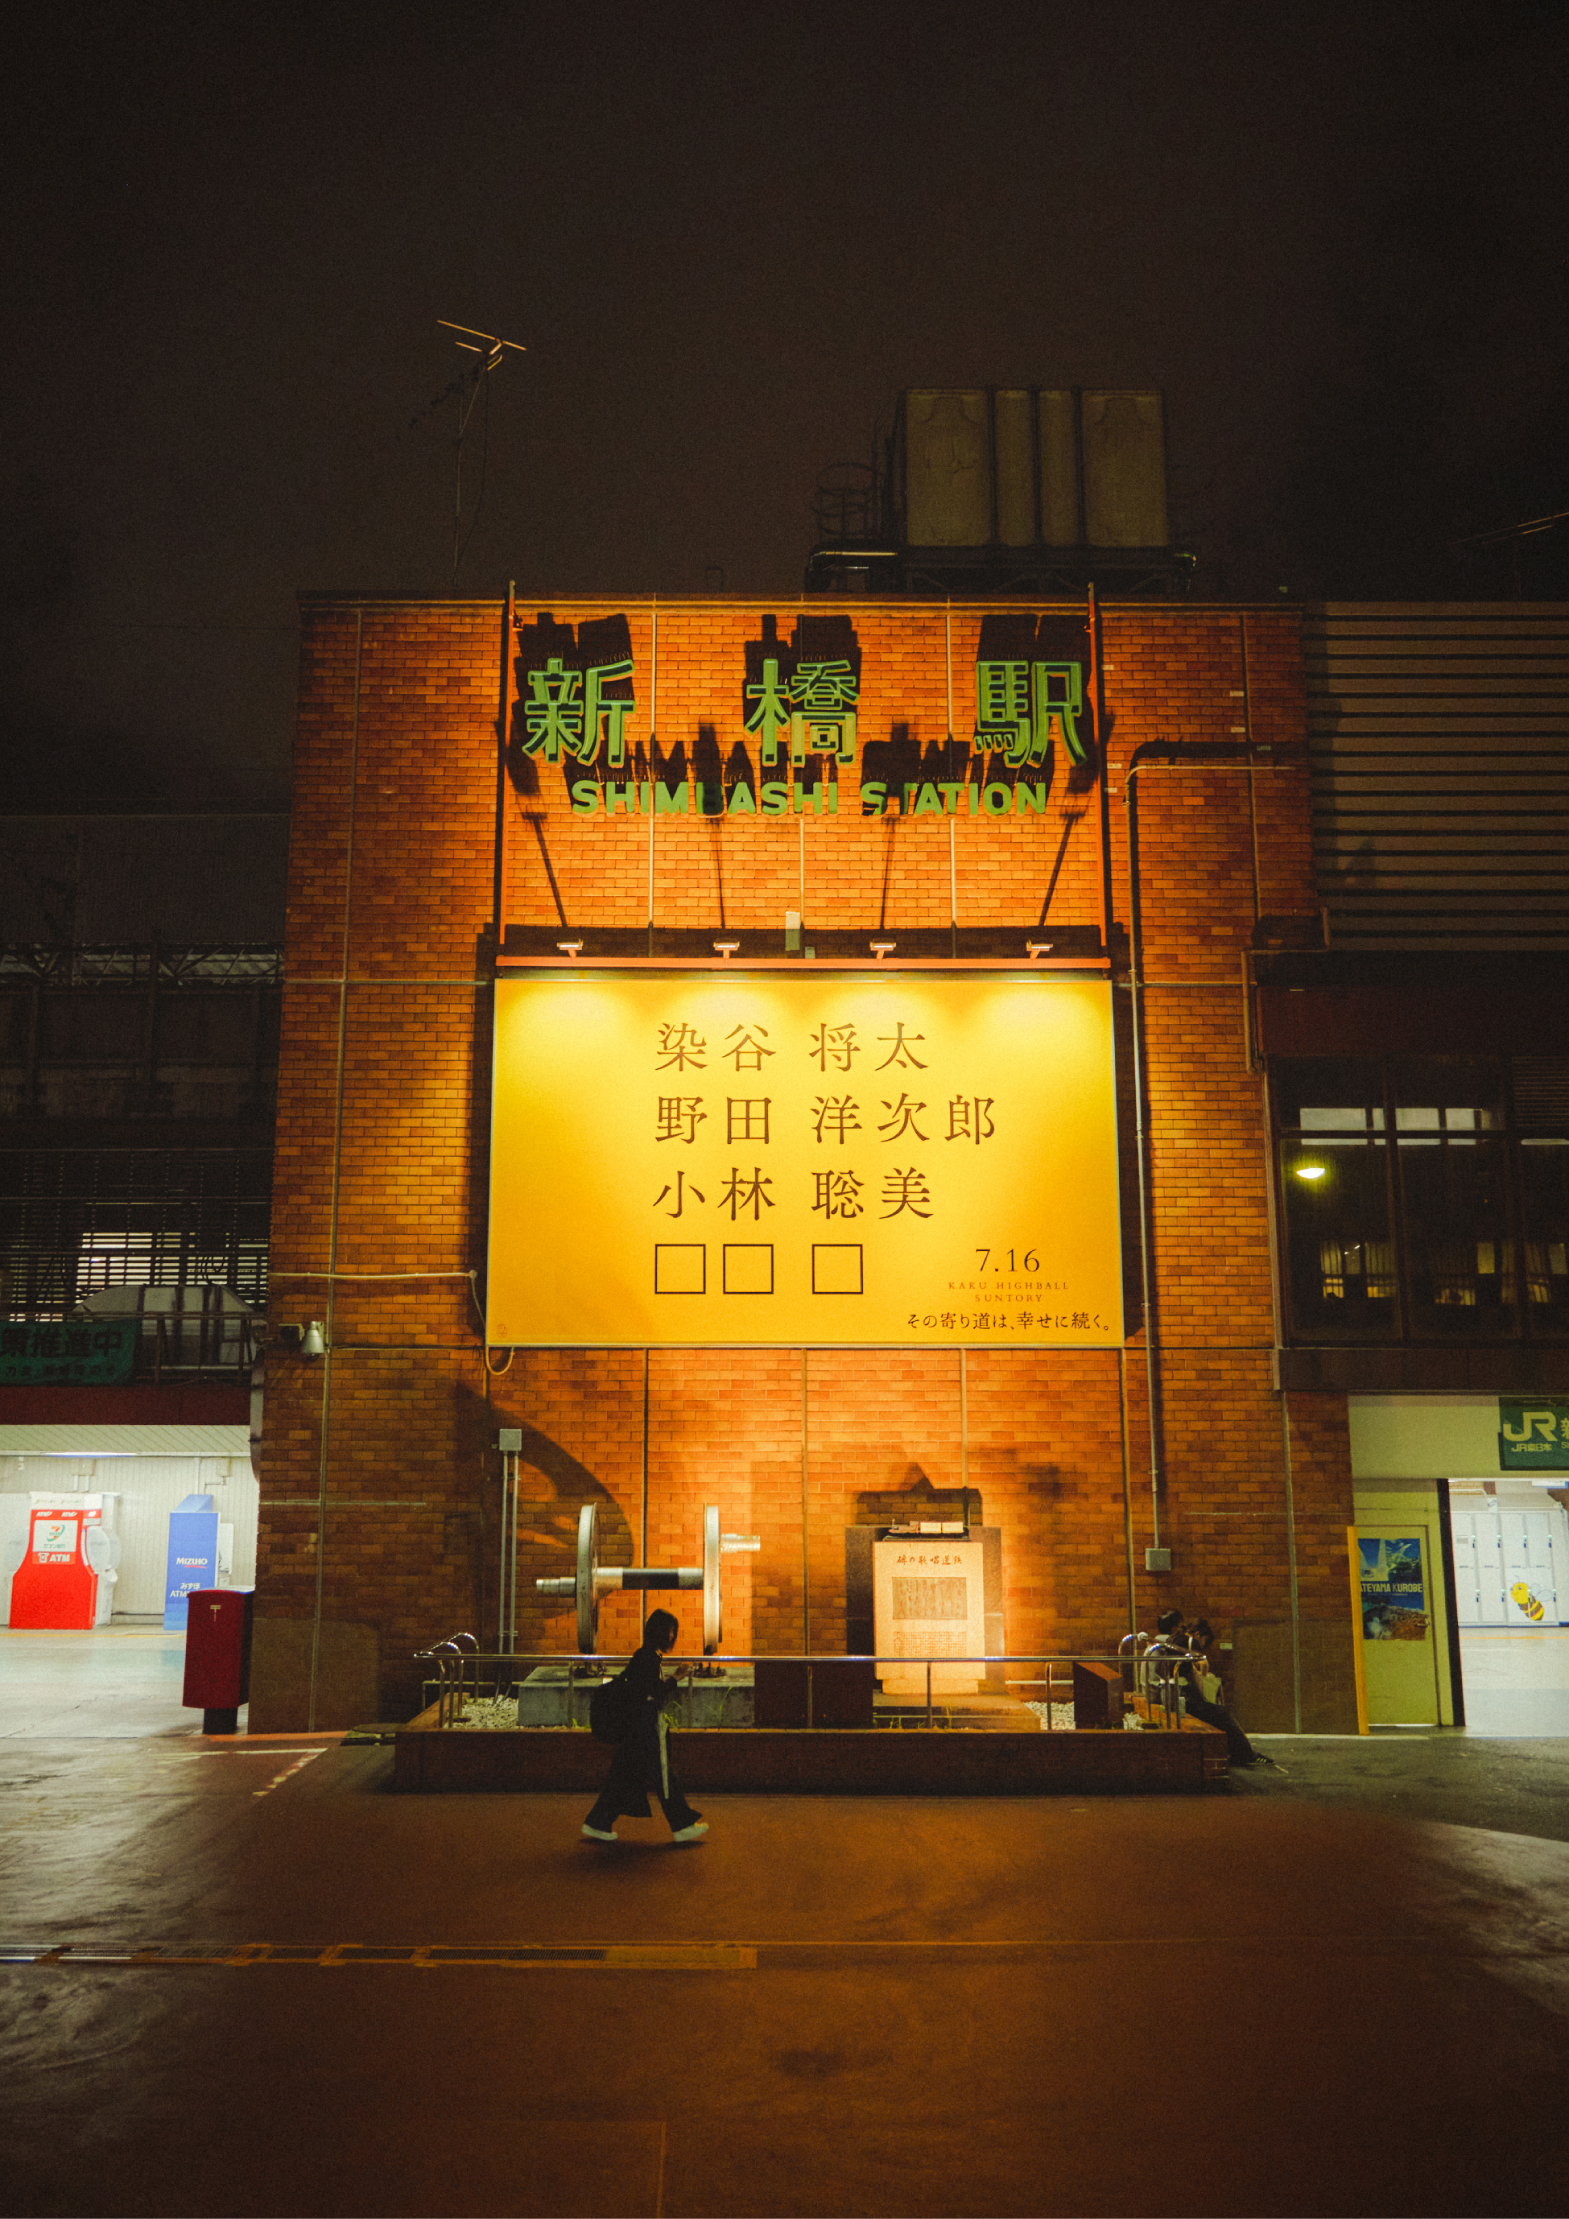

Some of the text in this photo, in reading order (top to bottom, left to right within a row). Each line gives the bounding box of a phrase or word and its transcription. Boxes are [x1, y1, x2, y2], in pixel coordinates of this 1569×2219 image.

[571, 780, 1047, 817] SHIMBASHI STATION
[655, 1022, 928, 1072] 染谷 将太
[655, 1092, 995, 1145] 野田 洋次郎
[652, 1167, 934, 1221] 小林 聡美
[975, 1248, 1040, 1272] 7.16
[948, 1282, 1069, 1290] KAKU HIGHBALL
[975, 1294, 1043, 1302] SUNTORY
[907, 1311, 1109, 1331] その寄り道は、幸せに続く。
[1503, 1412, 1558, 1441] JR
[49, 1554, 70, 1562] ATM
[176, 1557, 208, 1565] MIZUHO
[169, 1590, 189, 1598] ATM
[1392, 1583, 1423, 1593] KUROBE
